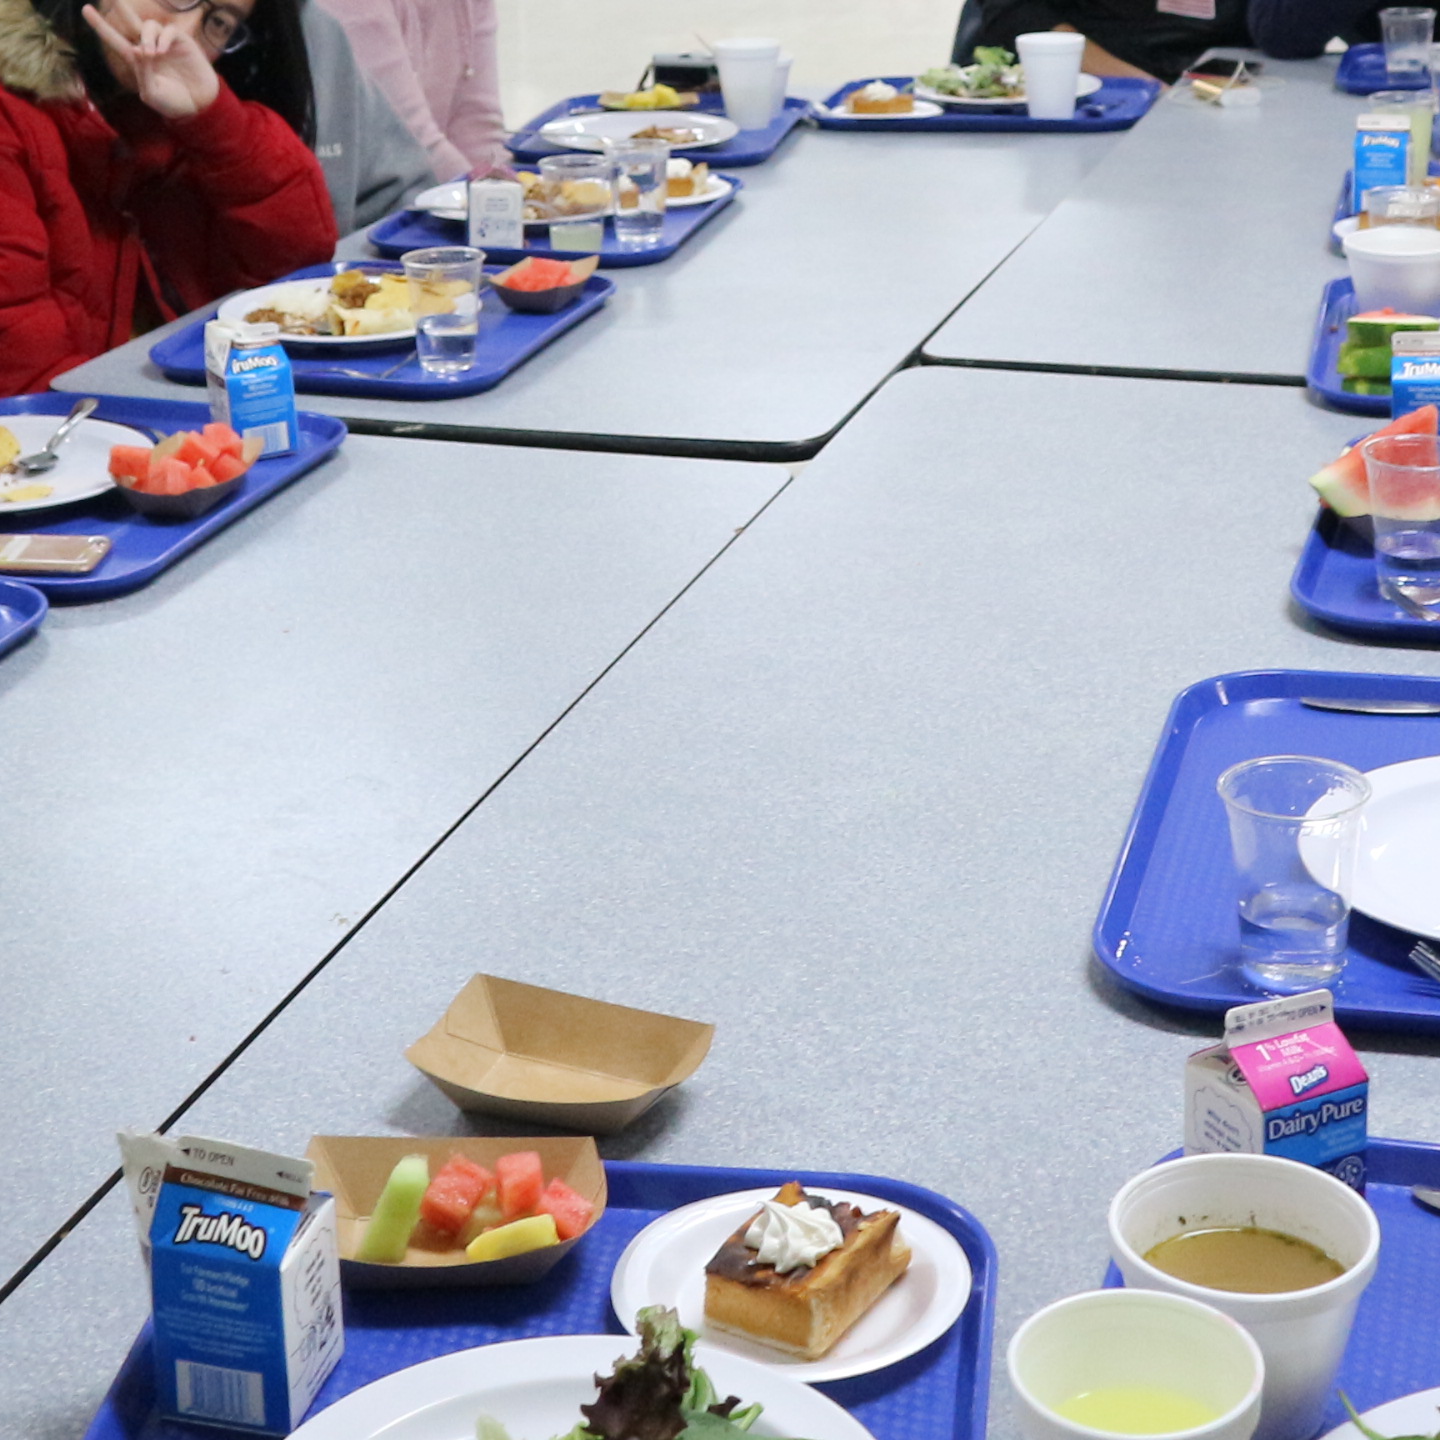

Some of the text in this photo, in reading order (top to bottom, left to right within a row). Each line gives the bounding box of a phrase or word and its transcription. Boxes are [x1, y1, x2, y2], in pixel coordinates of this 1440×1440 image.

[193, 1148, 236, 1167] TO OPEN
[180, 1172, 229, 1193] Chocolate
[173, 1206, 267, 1260] TruMoo
